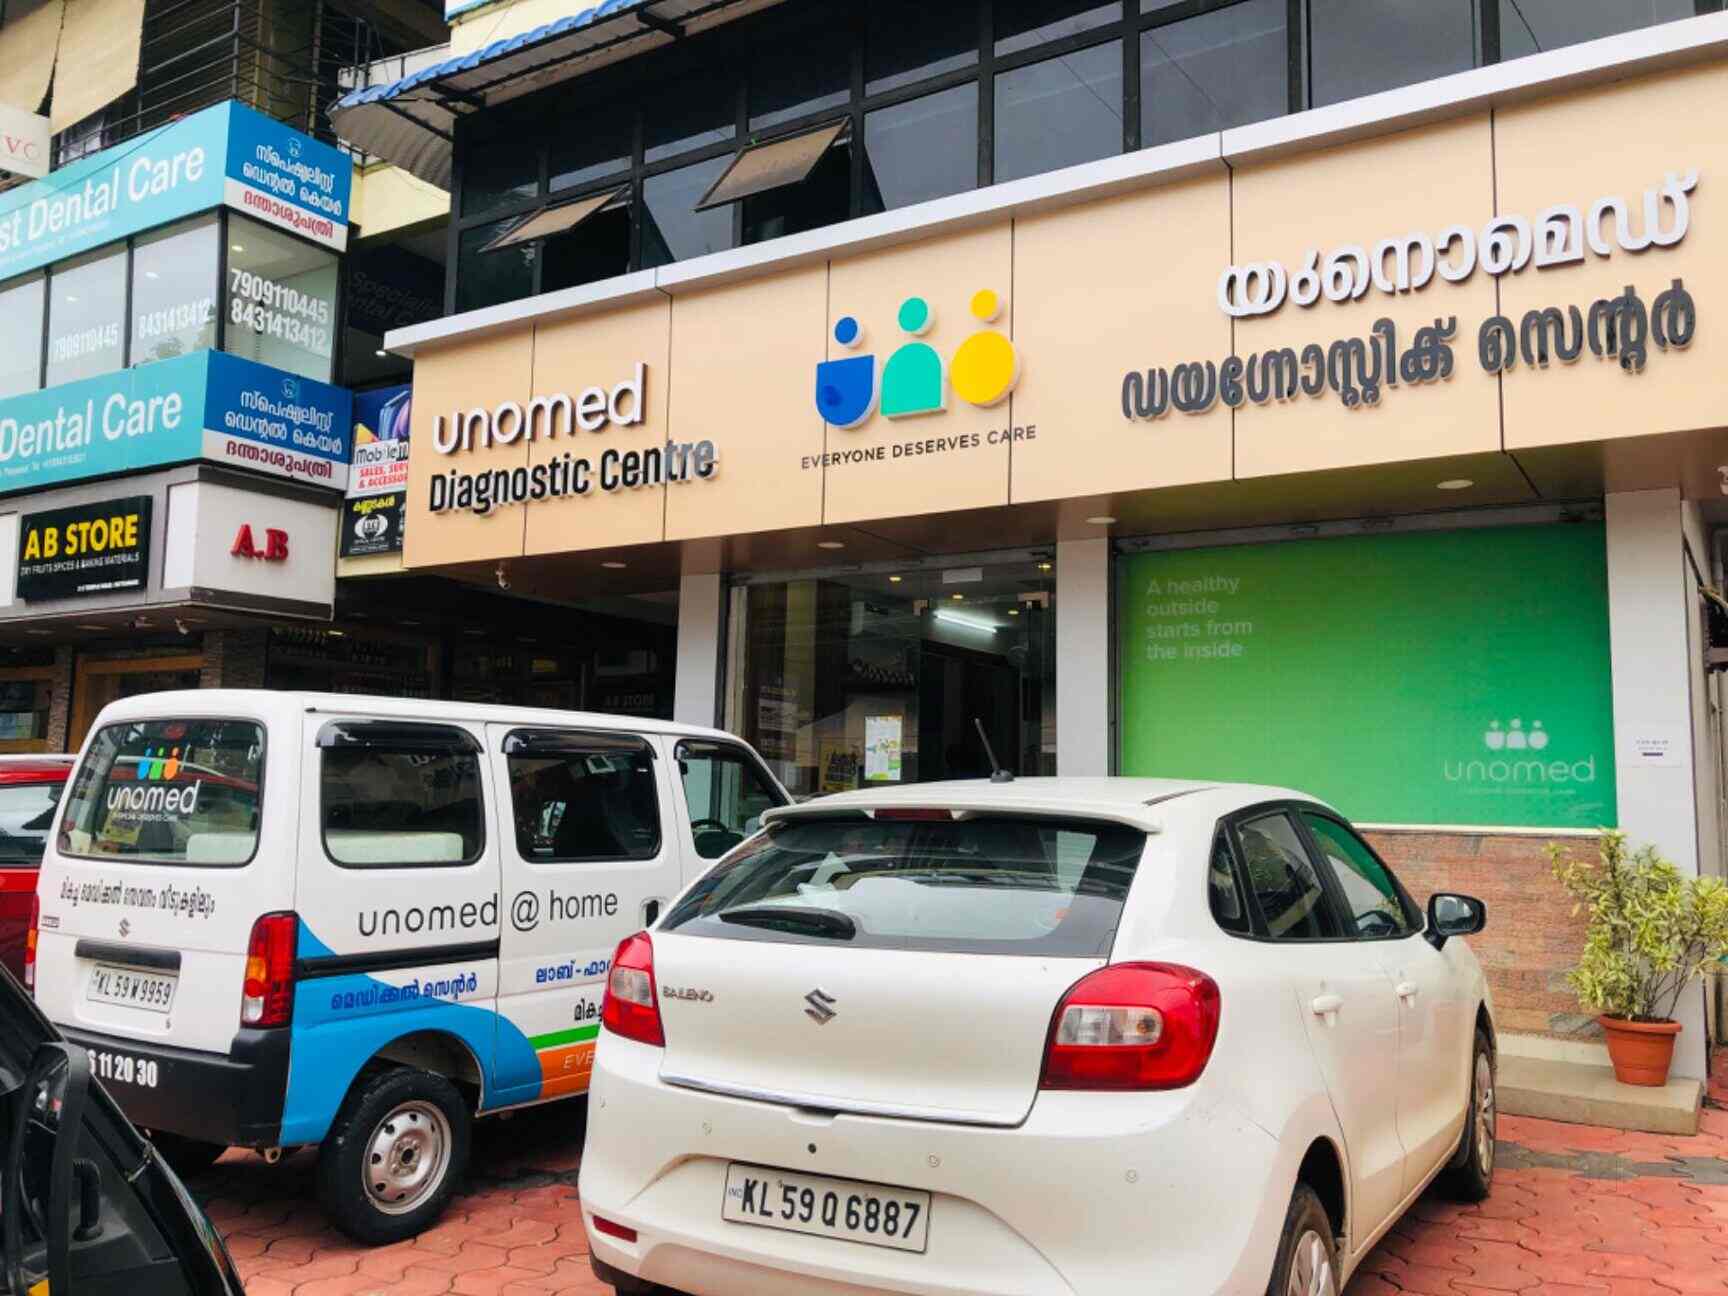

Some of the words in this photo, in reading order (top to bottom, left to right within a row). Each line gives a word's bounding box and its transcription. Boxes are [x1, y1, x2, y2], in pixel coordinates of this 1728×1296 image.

[0, 209, 21, 252] st
[28, 165, 119, 240] Dental
[127, 146, 205, 202] Care
[231, 268, 329, 325] 7909110445
[231, 298, 326, 351] 8431413412
[0, 399, 92, 462] Dental
[101, 391, 182, 442] Care
[432, 361, 648, 454] unomed
[801, 447, 886, 470] EVERYONE
[892, 433, 981, 459] DESERVES
[987, 425, 1037, 446] CARE
[429, 452, 590, 514] Diagnostic
[600, 439, 716, 491] Centre
[65, 513, 139, 555] STORE
[1146, 579, 1161, 595] A
[1167, 576, 1241, 595] healthy
[1146, 597, 1220, 617] outside
[1146, 621, 1200, 640] starts
[1206, 618, 1253, 636] from
[1146, 641, 1178, 660] the
[1184, 639, 1243, 659] inside
[1443, 754, 1596, 784] unomed
[106, 779, 202, 814] unomed
[358, 893, 498, 937] unomed
[511, 890, 540, 932] @
[550, 889, 618, 921] home
[663, 985, 714, 1002] BALENO
[98, 1052, 113, 1079] 11
[114, 1055, 134, 1083] 20
[136, 1058, 158, 1088] 30
[563, 1053, 597, 1070] EVE
[741, 1178, 773, 1217] KL
[781, 1185, 815, 1223] 59
[821, 1191, 838, 1228] Q
[845, 1195, 921, 1240] 6887
